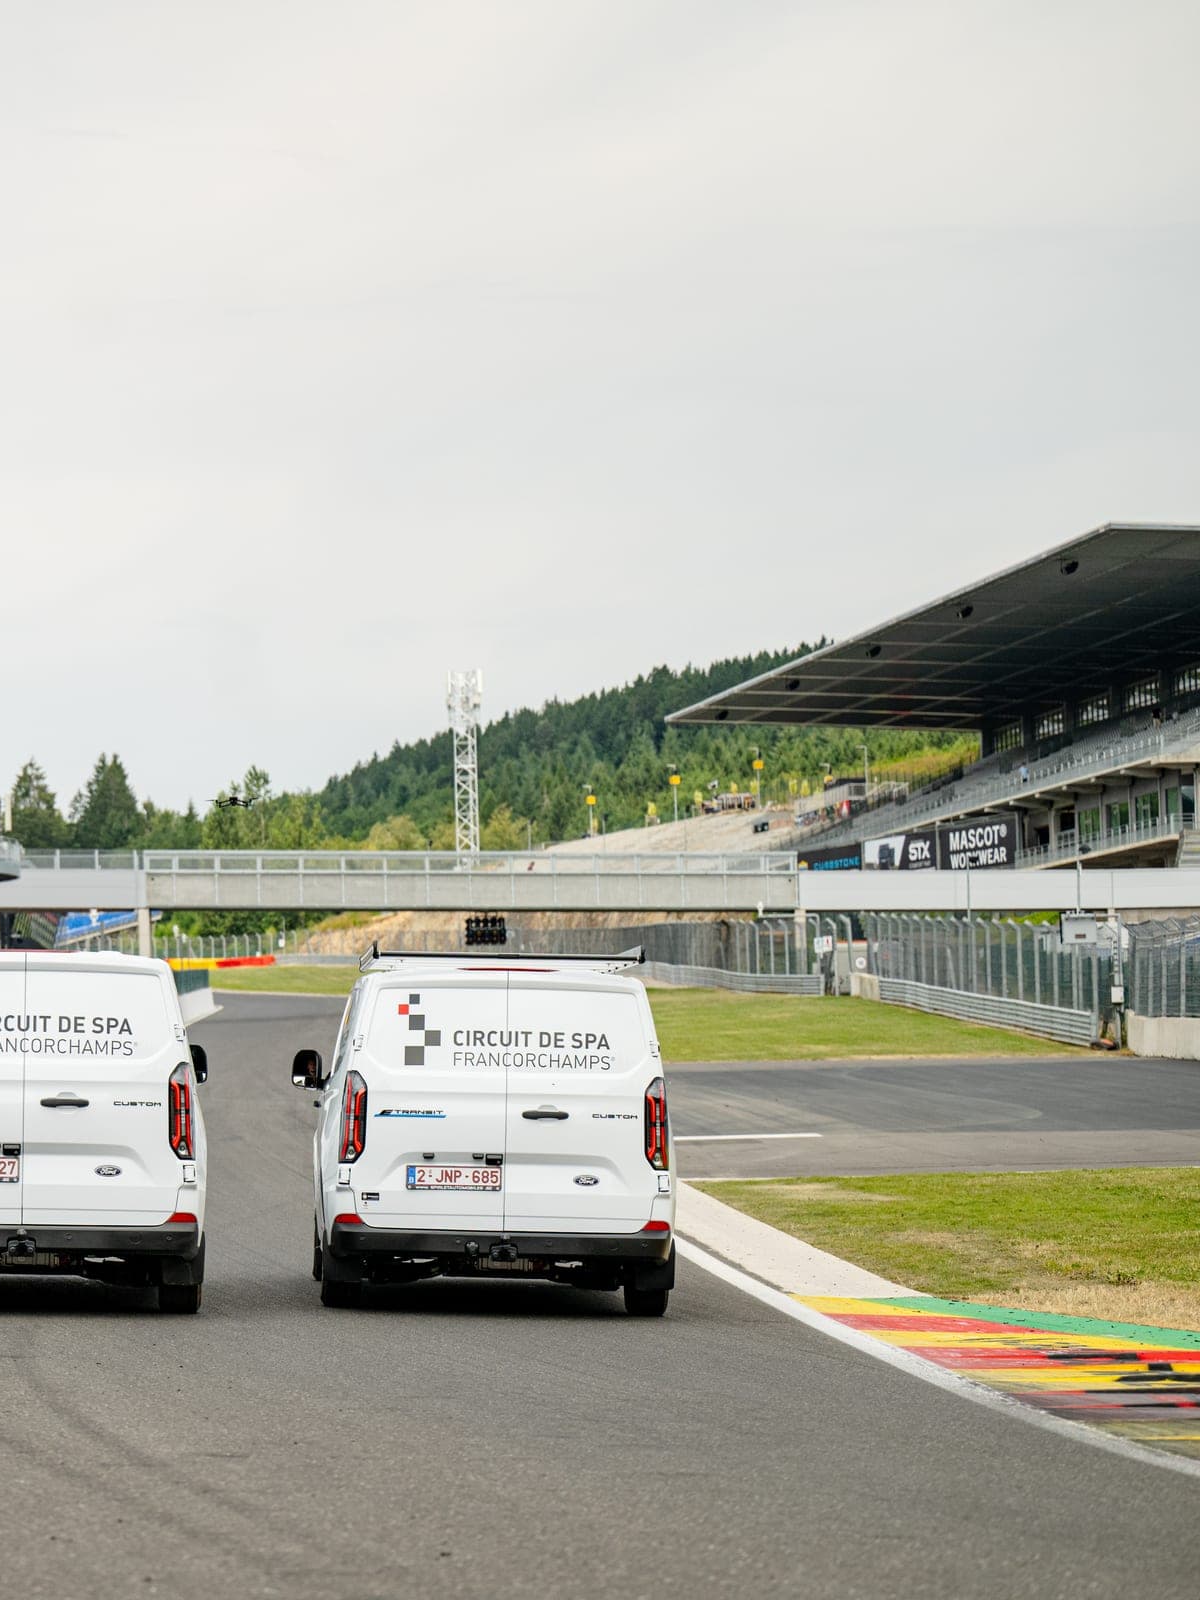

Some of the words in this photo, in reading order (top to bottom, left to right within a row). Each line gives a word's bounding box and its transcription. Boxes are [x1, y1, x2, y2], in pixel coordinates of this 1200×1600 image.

[909, 841, 930, 861] STX
[58, 1016, 86, 1033] DE
[91, 1017, 133, 1035] SPA
[453, 1030, 533, 1047] CIRCUIT
[539, 1031, 565, 1048] DE
[571, 1032, 611, 1050] SPA
